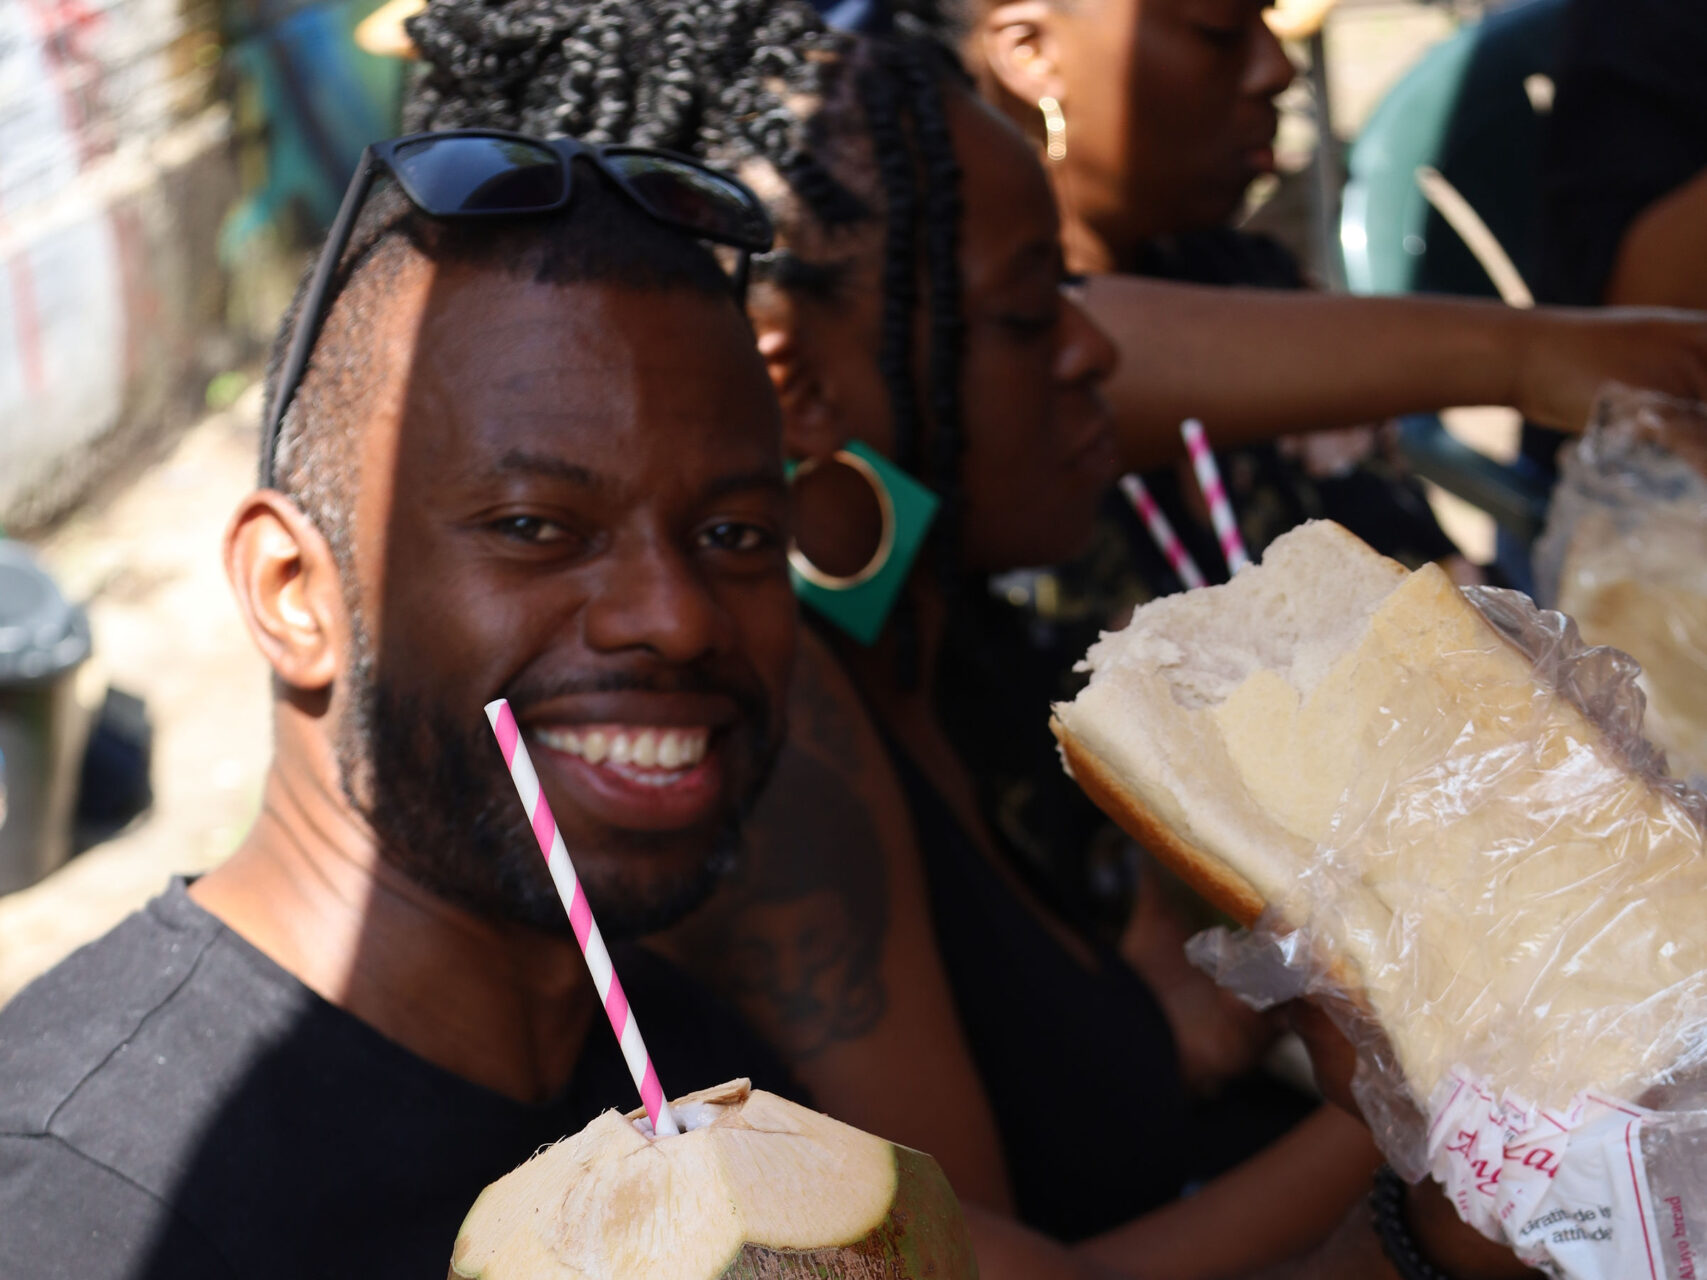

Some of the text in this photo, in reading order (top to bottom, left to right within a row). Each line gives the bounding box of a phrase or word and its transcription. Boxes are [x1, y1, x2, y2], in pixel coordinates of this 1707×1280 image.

[1520, 1207, 1597, 1235] Gratitde
[1663, 1195, 1686, 1239] bread
[1552, 1223, 1613, 1244] attitde
